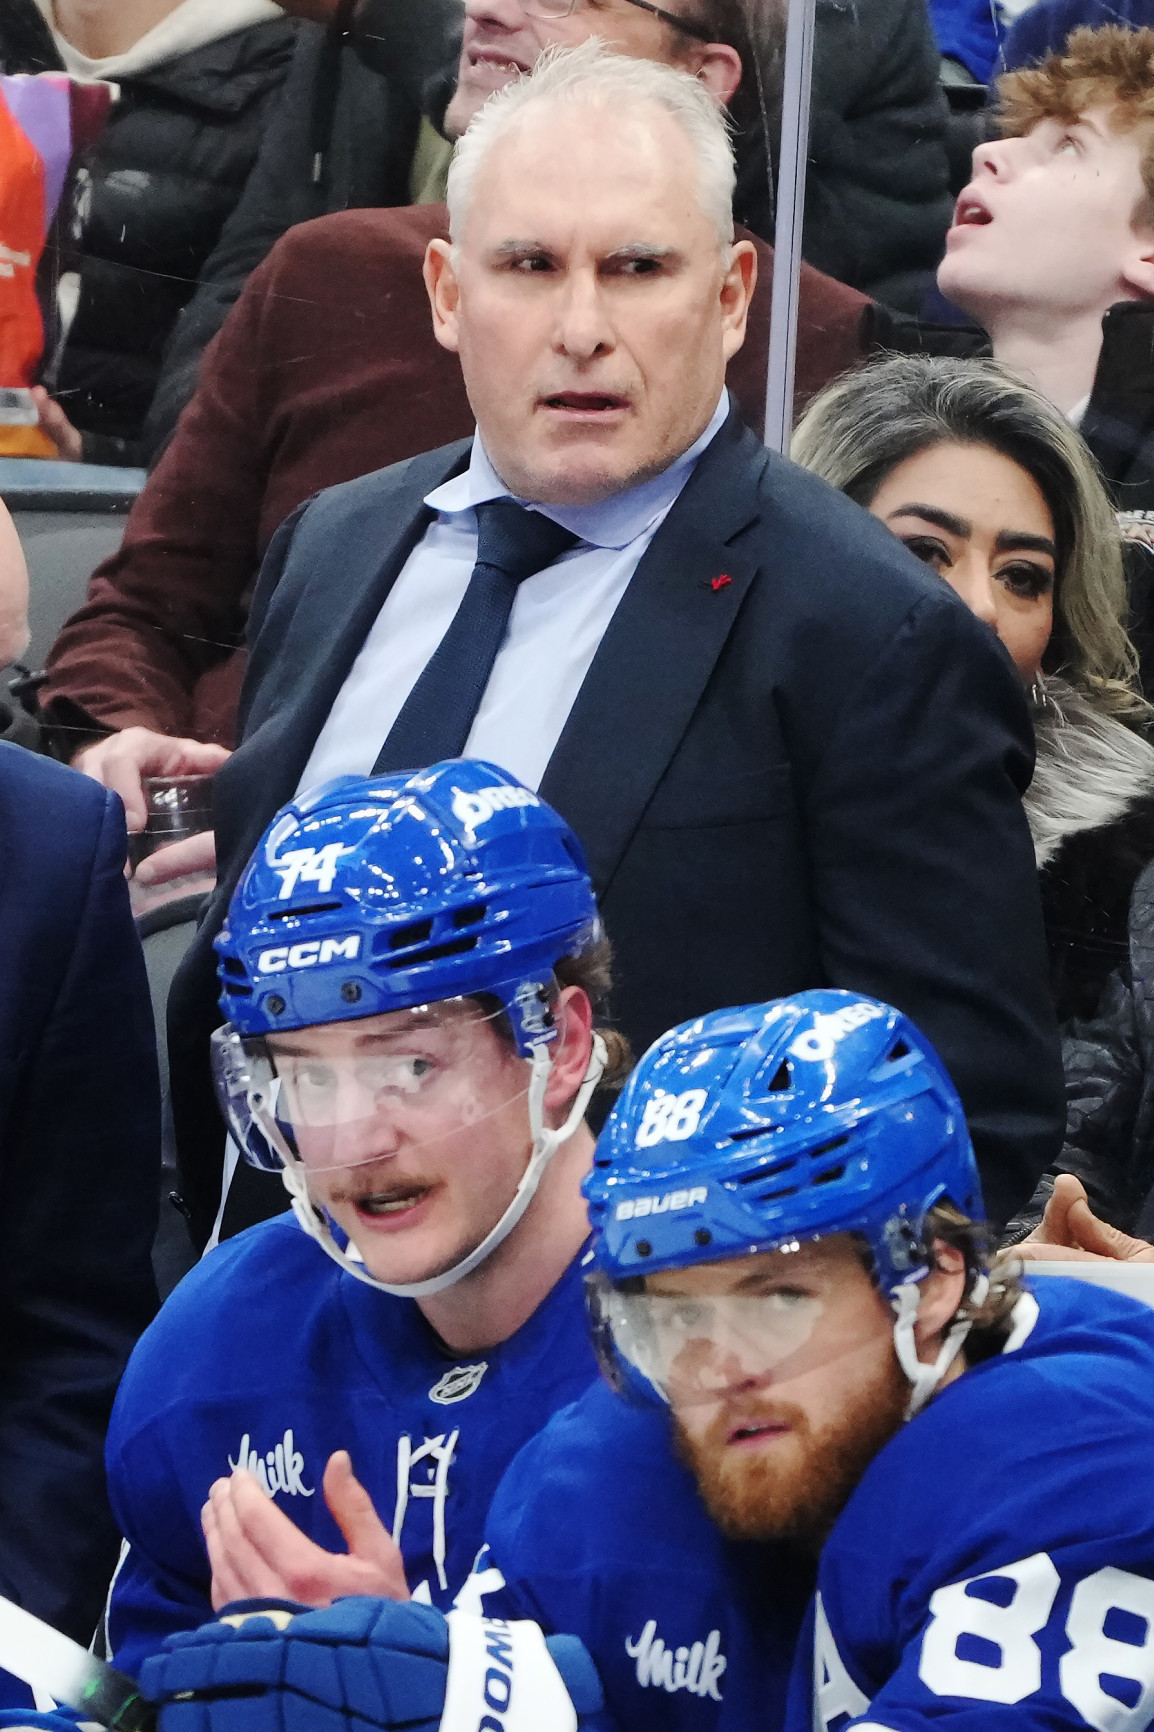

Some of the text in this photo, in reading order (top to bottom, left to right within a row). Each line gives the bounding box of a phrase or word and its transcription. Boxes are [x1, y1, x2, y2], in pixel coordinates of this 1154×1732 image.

[276, 842, 350, 900] 74
[257, 935, 361, 974] CCM
[634, 1088, 708, 1148] 88
[625, 1619, 728, 1702] Milk
